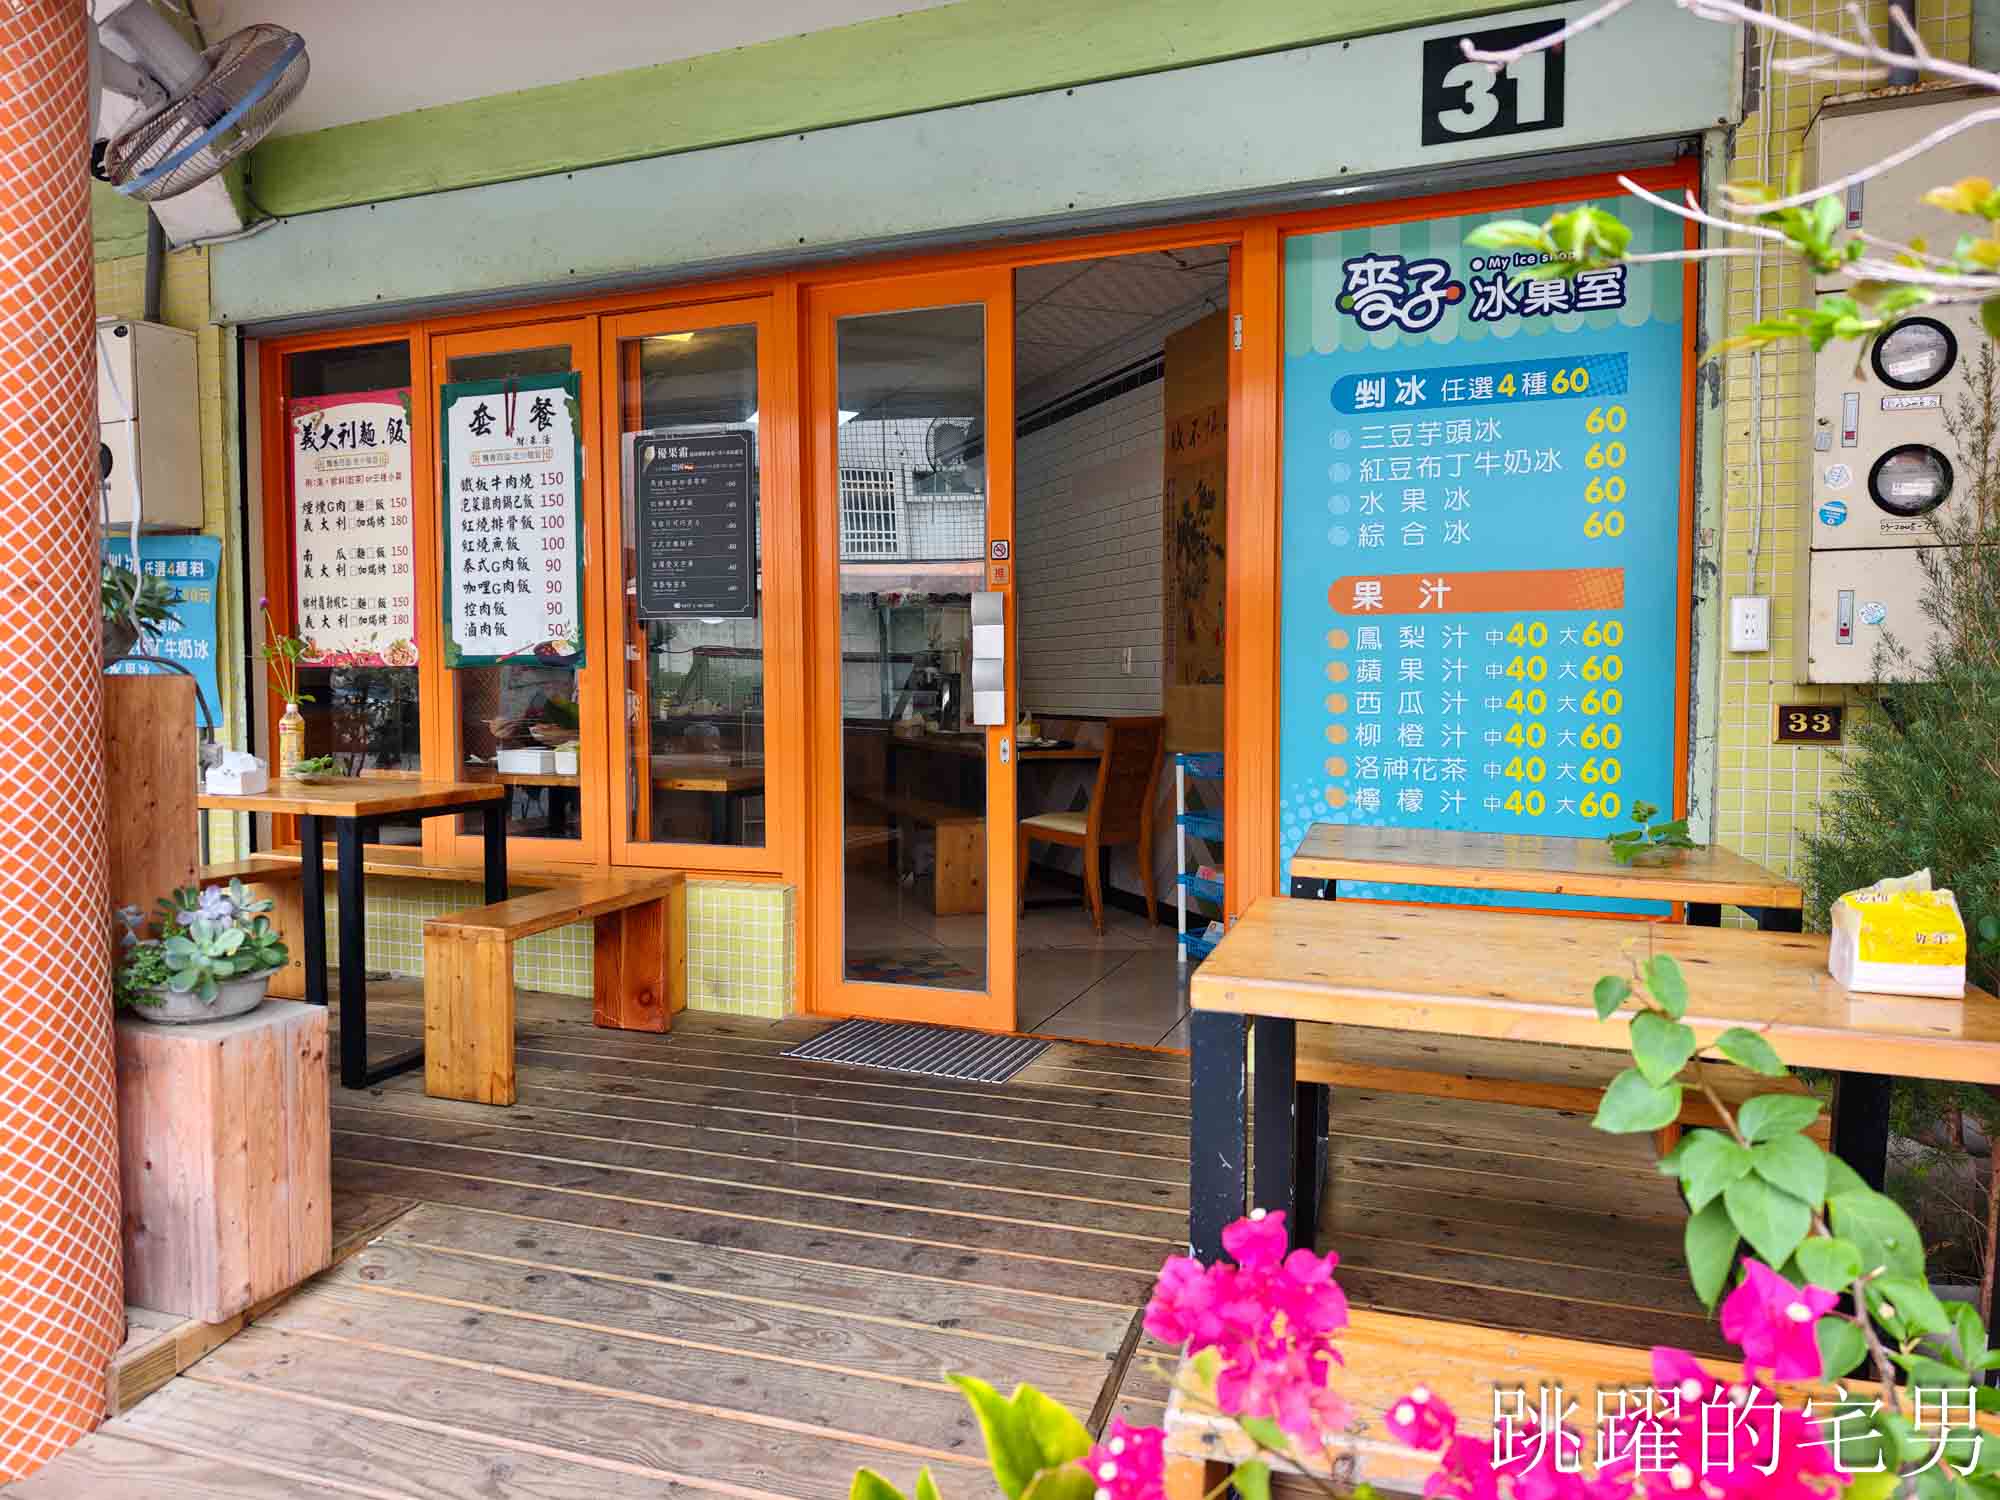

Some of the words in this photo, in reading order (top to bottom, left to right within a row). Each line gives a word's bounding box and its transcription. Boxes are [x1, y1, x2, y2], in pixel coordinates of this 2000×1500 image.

[1438, 50, 1546, 134] 31
[1488, 258, 1509, 269] My
[1515, 254, 1536, 265] Ice
[1345, 256, 1450, 330] 麥子
[1472, 266, 1624, 319] 冰果室
[1359, 417, 1502, 450] 三豆芋頭冰
[1586, 406, 1628, 434] 60
[1359, 448, 1562, 483] 紅豆布丁牛奶冰
[1584, 441, 1627, 470] 60
[541, 472, 564, 486] 150
[391, 497, 407, 508] 150
[541, 494, 564, 507] 150
[1359, 486, 1472, 516] 水果冰
[1584, 476, 1627, 504] 60
[462, 515, 535, 533] 紅燒排骨飯
[541, 515, 565, 529] 100
[1583, 511, 1625, 539] 60
[391, 546, 408, 557] 150
[462, 537, 520, 553] 紅燒魚飯
[542, 537, 565, 551] 100
[392, 564, 409, 575] 180
[463, 557, 531, 574] 泰式G肉飯
[545, 558, 562, 572] 90
[463, 579, 531, 595] 咖哩G肉飯
[545, 580, 562, 593] 90
[393, 597, 409, 608] 150
[464, 601, 508, 617] 控肉飯
[546, 602, 562, 615] 90
[393, 615, 409, 626] 180
[465, 622, 508, 637] 滷肉飯
[547, 623, 563, 637] 50
[1356, 624, 1468, 651] 鳳梨汁
[1355, 657, 1468, 683] 蘋果汁
[1355, 690, 1469, 715] 西瓜汁
[1789, 712, 1832, 733] 33
[1355, 723, 1468, 748] 柳橙汁
[1355, 756, 1467, 782] 洛神花茶
[1355, 787, 1467, 814] 檸檬汁
